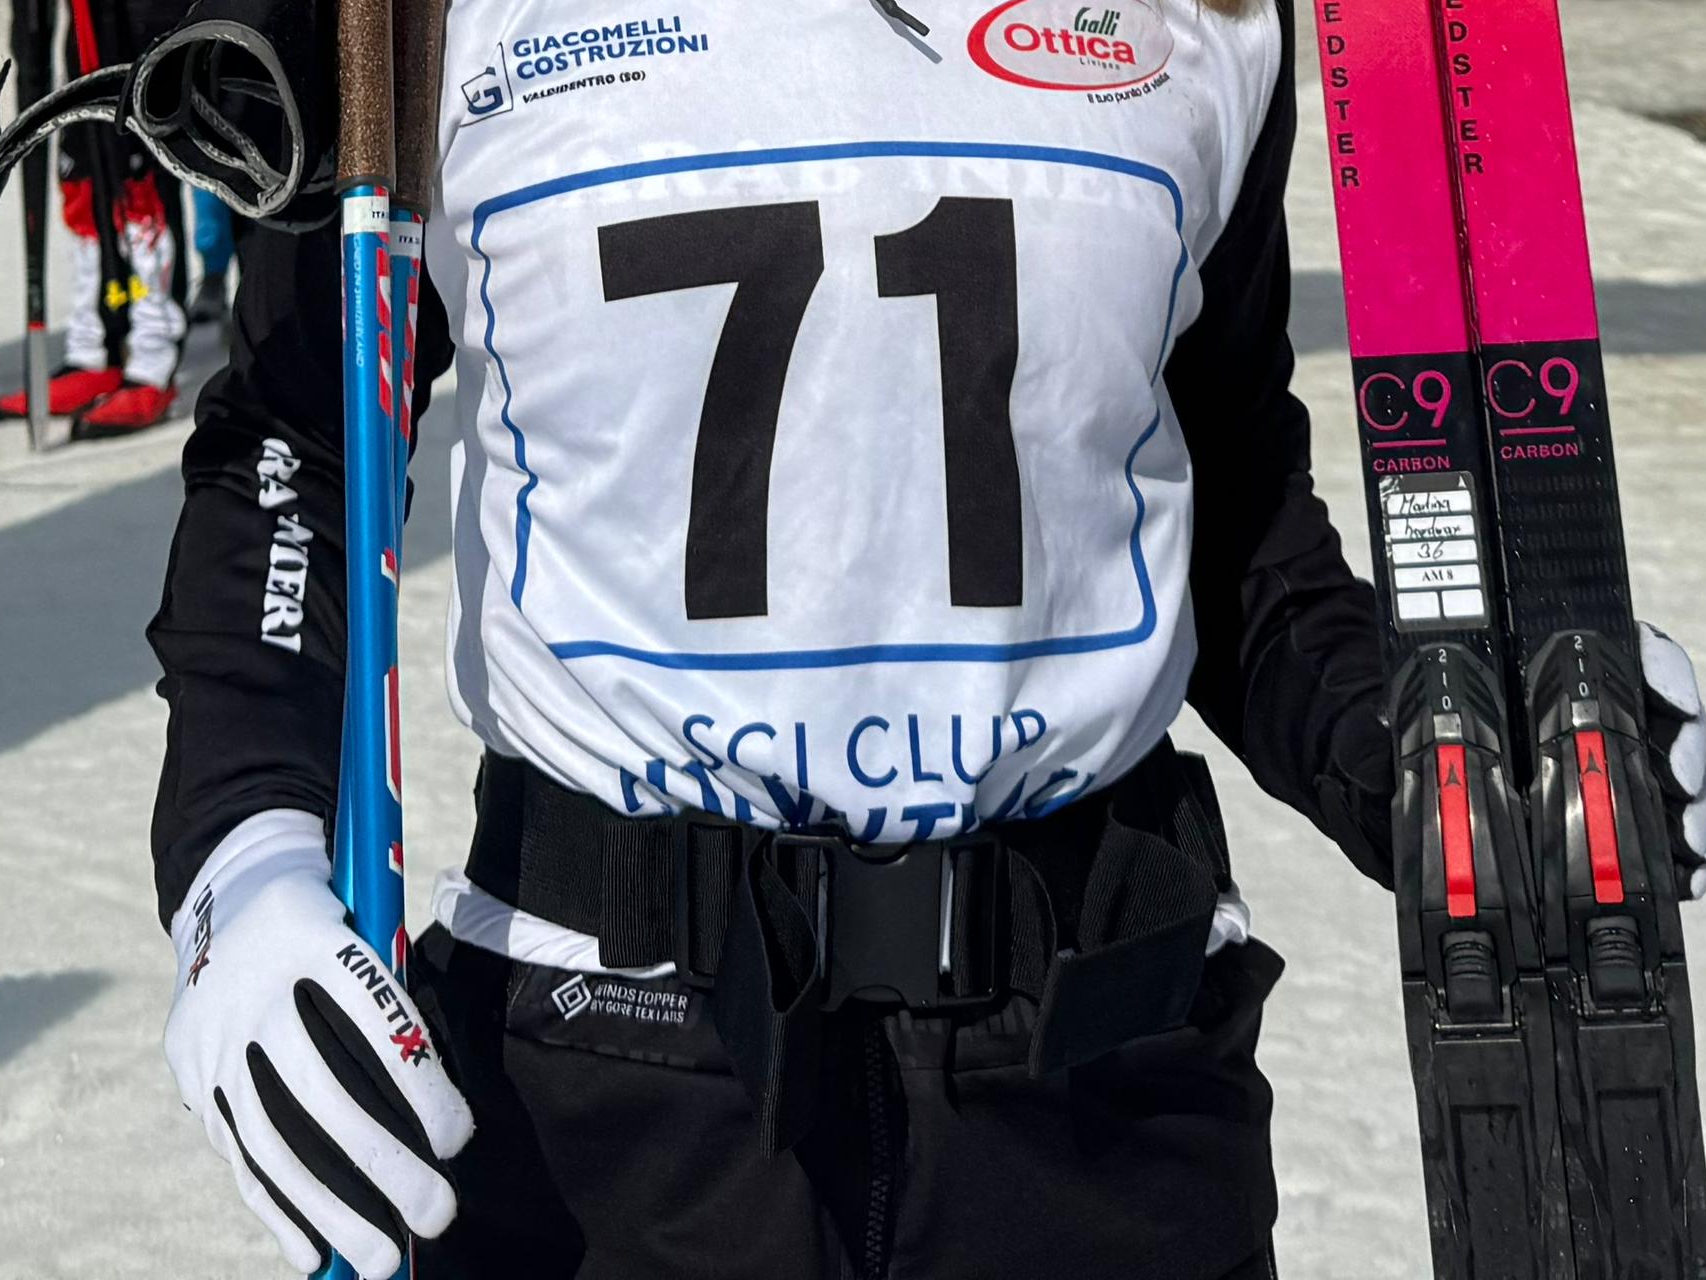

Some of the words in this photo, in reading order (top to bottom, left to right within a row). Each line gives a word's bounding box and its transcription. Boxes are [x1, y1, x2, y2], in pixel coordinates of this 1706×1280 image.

[512, 15, 682, 58] GIACOMELLI
[1074, 6, 1121, 36] Galli
[516, 33, 709, 80] COSTRUZIONI
[1003, 22, 1136, 65] Ottica
[522, 73, 616, 104] VALDIDENTRO
[619, 70, 647, 83] (SO)
[1359, 370, 1452, 431] C9
[1486, 357, 1580, 418] C9
[596, 195, 1023, 621] 71
[1373, 456, 1451, 473] CARBON
[1500, 443, 1580, 460] CARBON
[1417, 540, 1445, 560] 36
[1438, 648, 1447, 663] 2
[1574, 635, 1583, 650] 2
[682, 714, 808, 791] SCI
